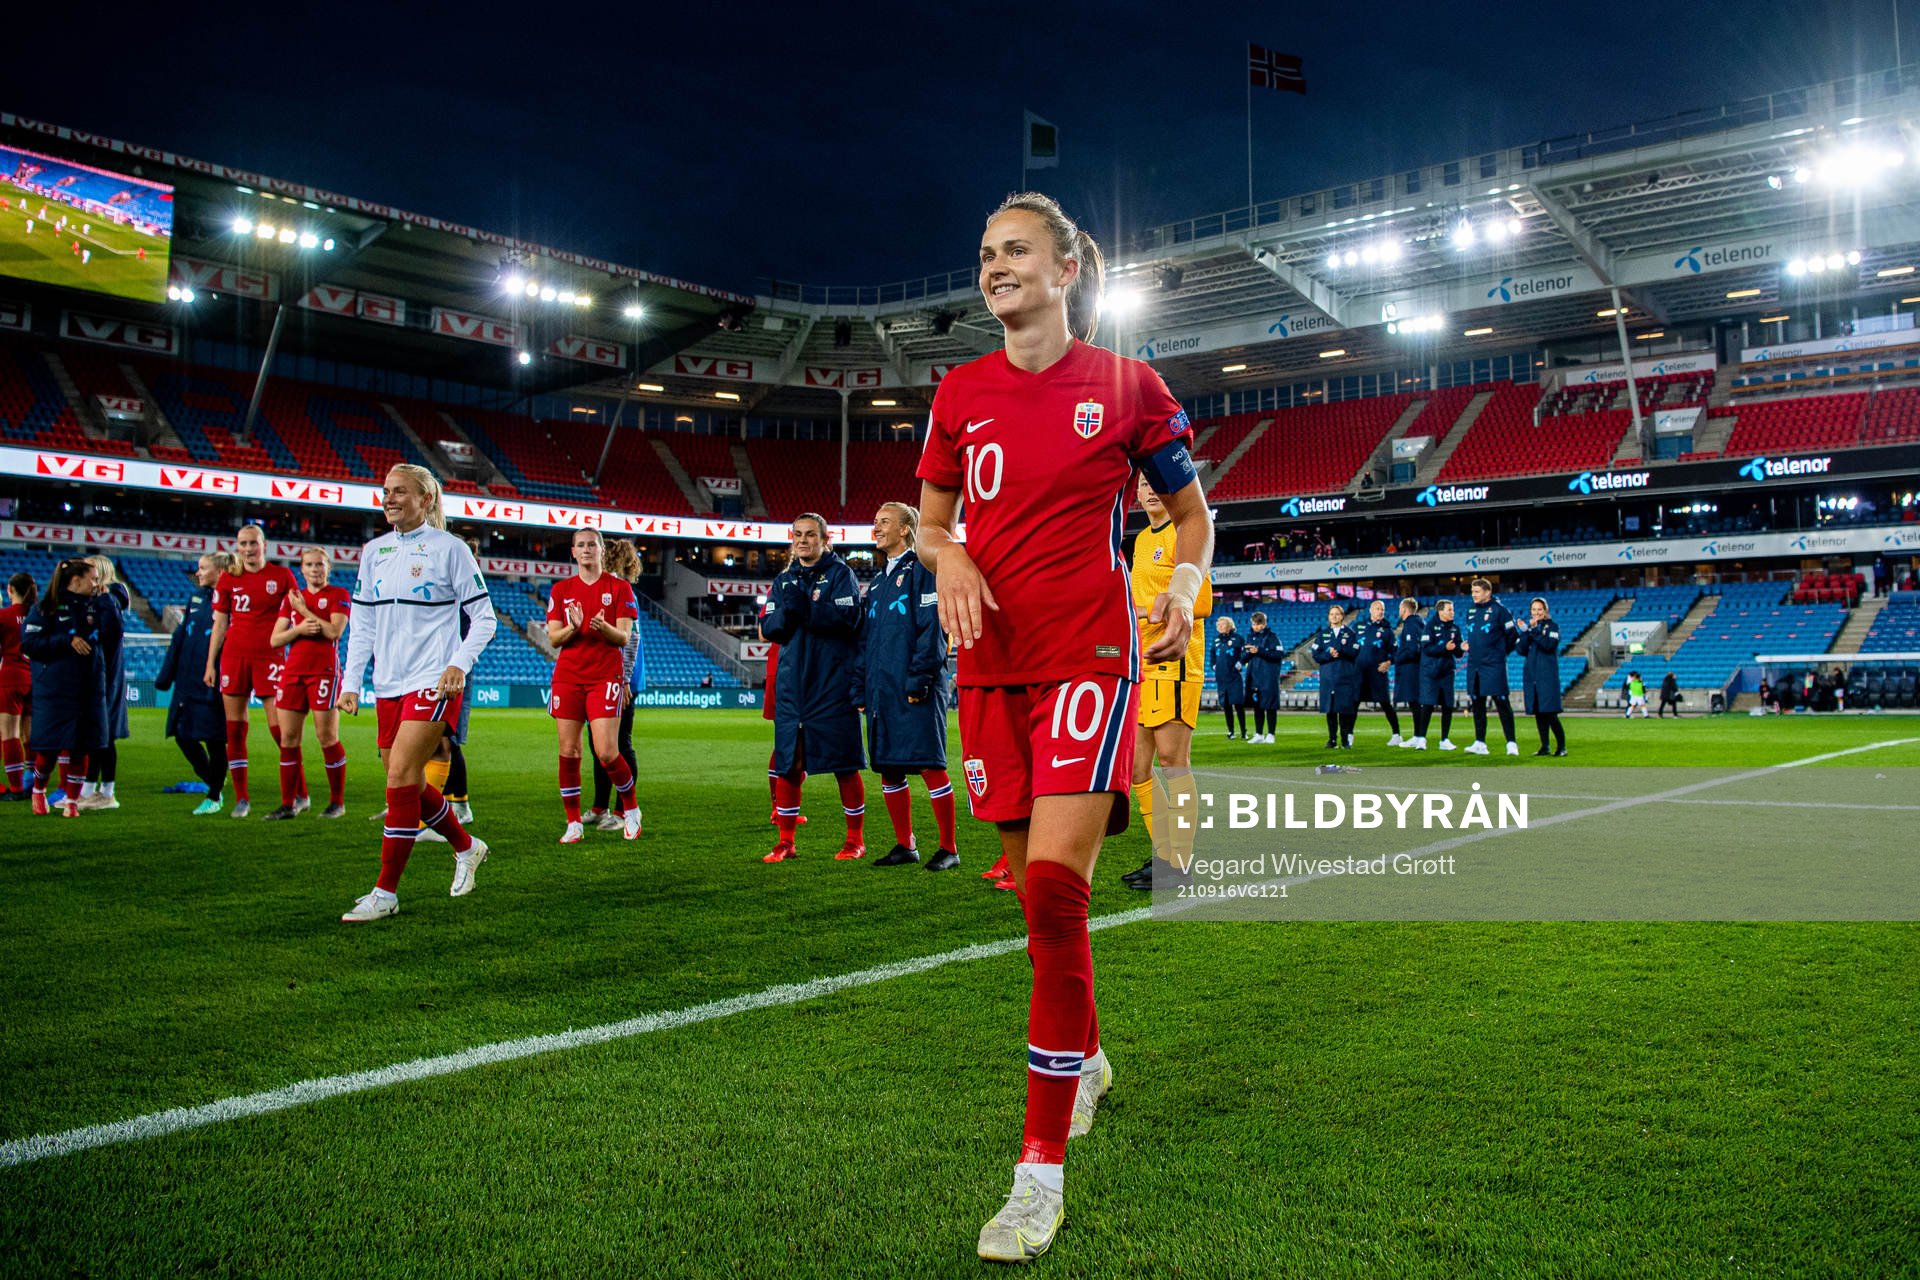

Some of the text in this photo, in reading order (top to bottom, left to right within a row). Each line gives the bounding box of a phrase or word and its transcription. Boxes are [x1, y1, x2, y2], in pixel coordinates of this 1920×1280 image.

[1704, 244, 1772, 266] telenor
[1514, 276, 1573, 296] telenor
[170, 257, 618, 366] VG VG VG VG
[69, 314, 172, 350] VG
[1156, 336, 1200, 353] telenor
[675, 355, 881, 387] VG VG
[1664, 360, 1697, 374] telenor
[704, 477, 738, 490] VG
[966, 442, 1003, 503] 10
[1299, 456, 1831, 513] telenor telenor telenor telenor
[37, 455, 762, 539] VG VG VG VG VG VG VG
[13, 524, 73, 541] VG
[84, 528, 141, 547] VG
[152, 534, 206, 550] VG
[489, 560, 527, 573] VG
[534, 563, 572, 576] VG
[1215, 570, 1242, 580] telenor
[1275, 566, 1304, 578] telenor
[1339, 562, 1368, 574] telenor
[1406, 558, 1437, 571] telenor
[1478, 555, 1510, 567] telenor
[1553, 551, 1587, 563] telenor
[1632, 546, 1668, 559] telenor
[1716, 541, 1755, 554] telenor
[1807, 535, 1847, 549] telenor
[710, 582, 754, 595] VG
[233, 594, 250, 612] 22
[318, 679, 329, 698] 5
[477, 689, 500, 704] DNB
[738, 690, 756, 706] DNB
[605, 682, 620, 701] 19
[1051, 681, 1104, 741] 10
